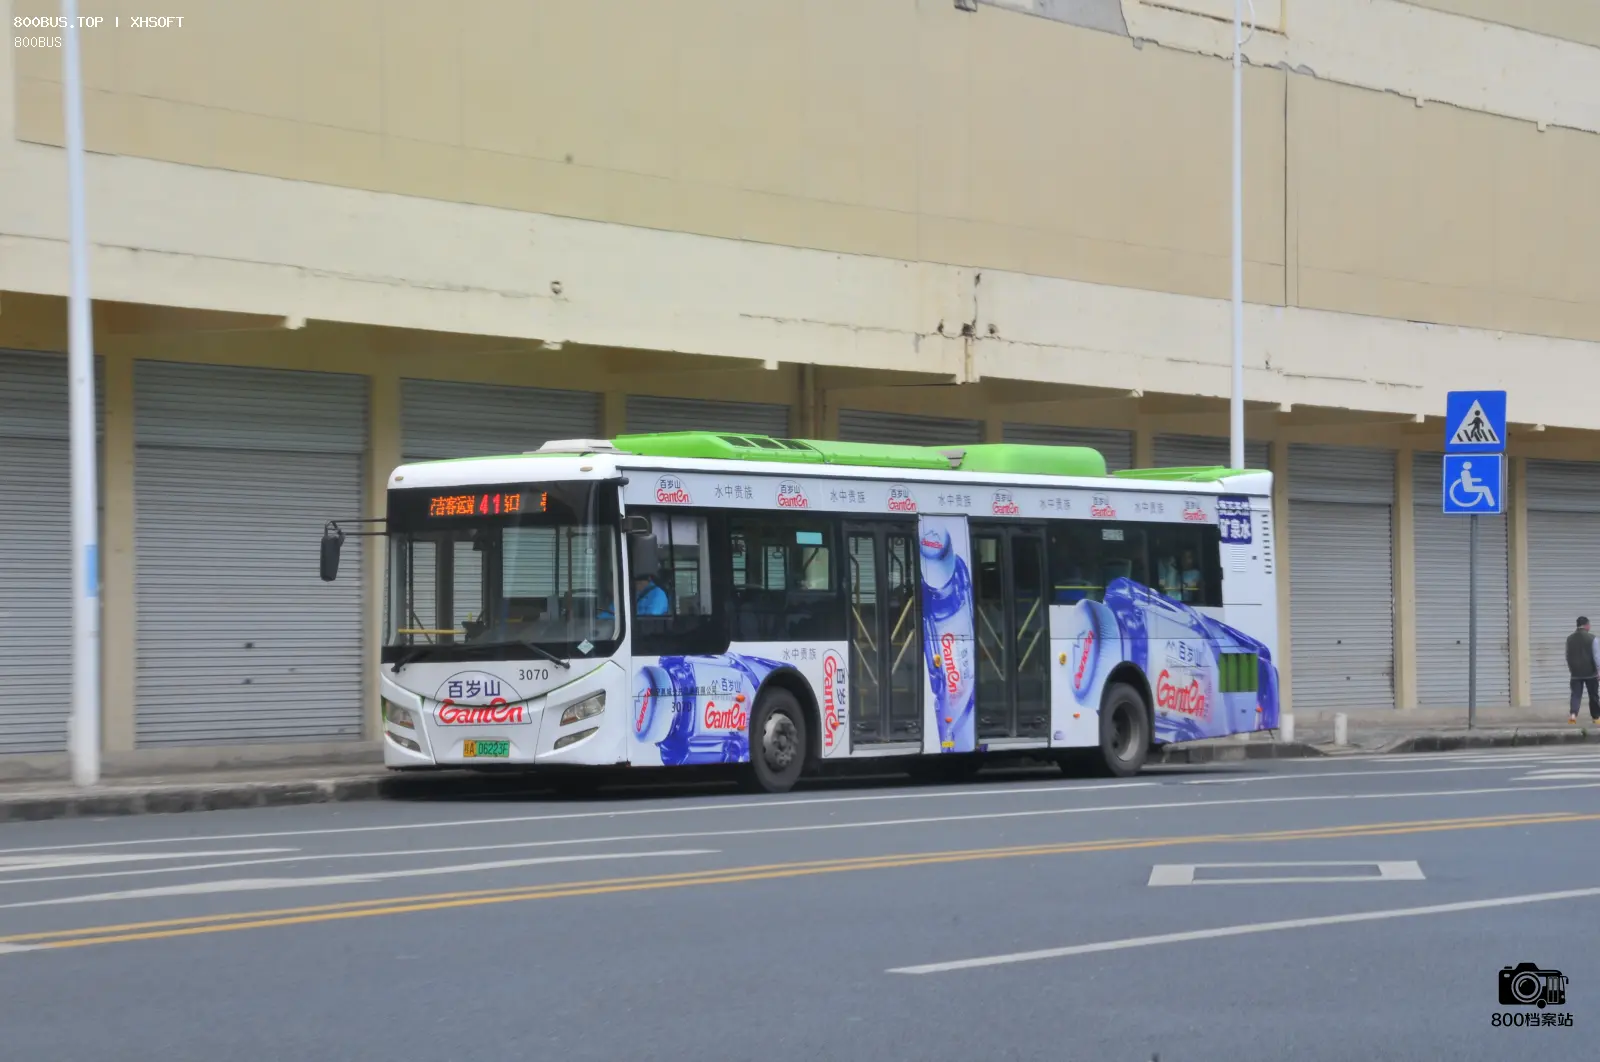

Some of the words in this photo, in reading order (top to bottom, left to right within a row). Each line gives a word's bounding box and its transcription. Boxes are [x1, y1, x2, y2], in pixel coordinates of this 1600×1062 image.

[659, 479, 681, 490] 百岁山
[714, 484, 753, 500] 水中贵族
[780, 484, 801, 495] 百岁山
[830, 488, 867, 504] 水中贵族
[890, 488, 910, 499] 百岁山
[479, 493, 500, 515] 41
[782, 647, 817, 661] 水中贵族
[519, 669, 549, 681] 3070
[448, 680, 501, 698] 百岁山
[836, 668, 846, 725] 百岁山
